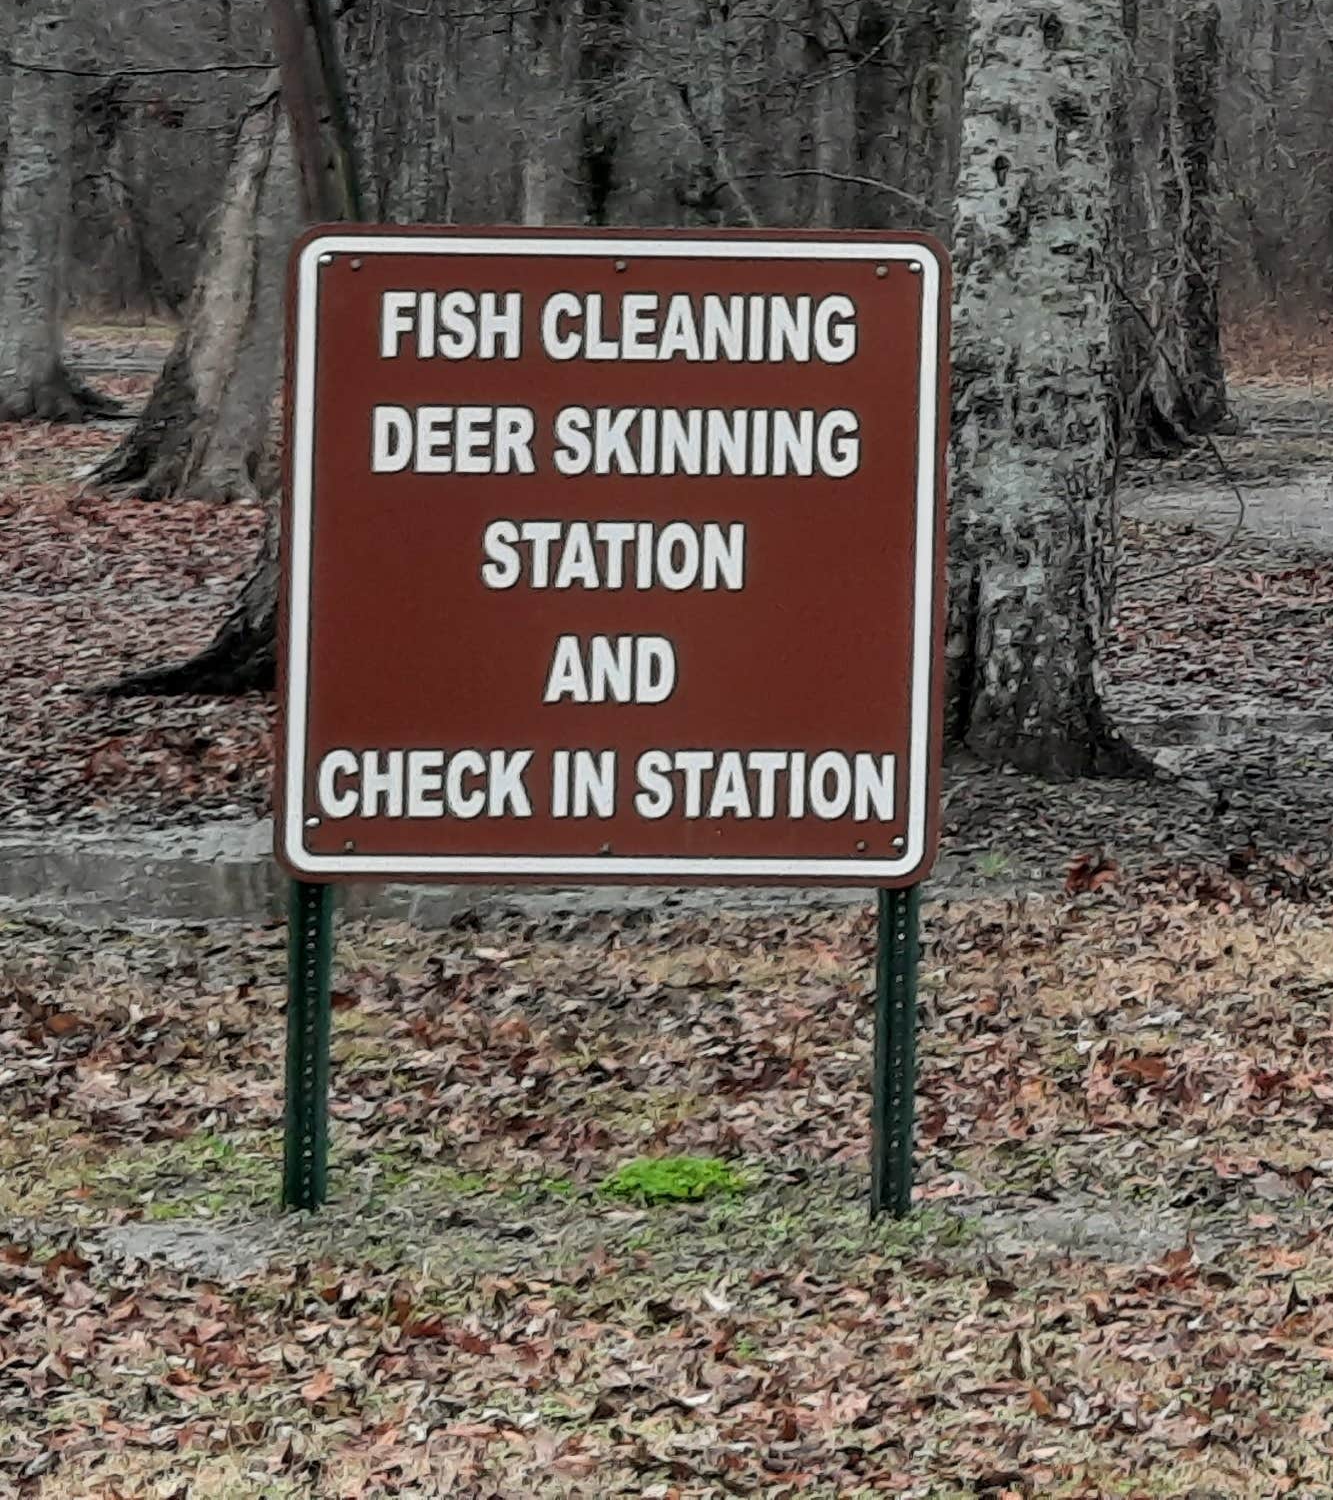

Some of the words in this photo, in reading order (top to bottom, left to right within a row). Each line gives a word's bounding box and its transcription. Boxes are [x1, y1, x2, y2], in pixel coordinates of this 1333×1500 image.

[380, 290, 522, 360] FISH
[540, 291, 857, 364] CLEANING
[371, 405, 536, 474] DEER
[552, 406, 860, 478] SKINNING
[481, 520, 745, 591] STATION
[542, 634, 676, 704] AND
[317, 748, 534, 819] CHECK
[551, 749, 617, 819] IN
[634, 749, 896, 822] STATION
